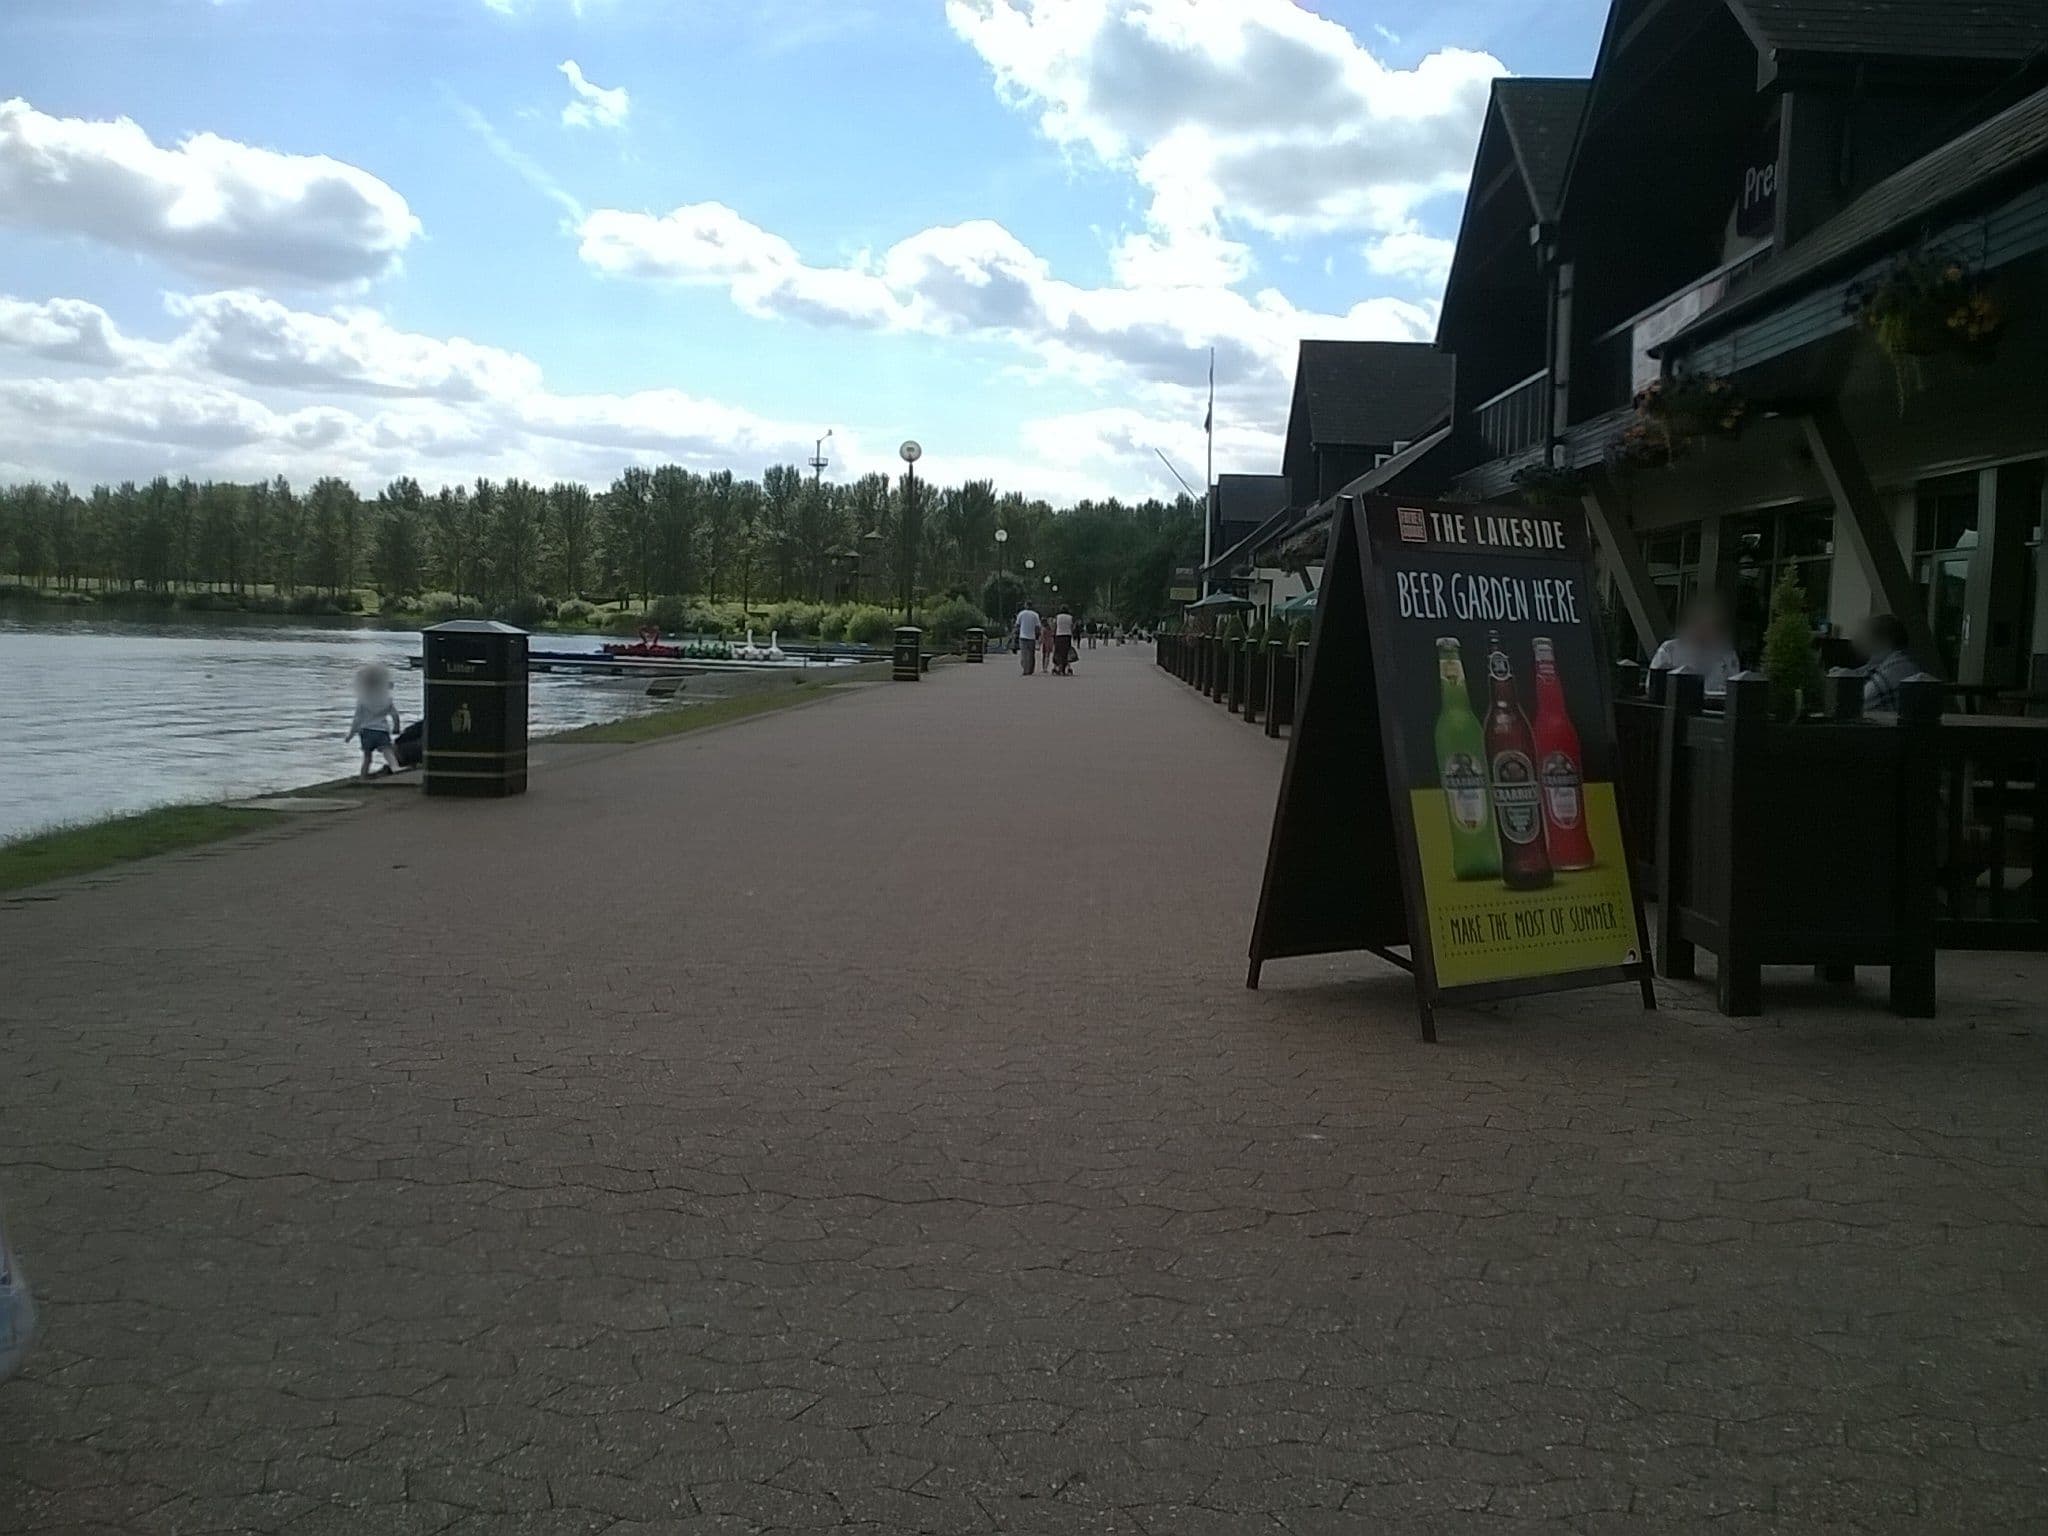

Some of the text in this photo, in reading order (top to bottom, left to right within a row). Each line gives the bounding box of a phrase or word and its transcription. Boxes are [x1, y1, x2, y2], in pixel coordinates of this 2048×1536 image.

[1744, 163, 1778, 210] Pre
[1430, 512, 1468, 544] THE
[1474, 516, 1566, 549] LAKESIDE
[1396, 570, 1581, 623] BEER GARDEN HERE
[1450, 902, 1617, 945] MAKE THE MOST OF SUMMER
